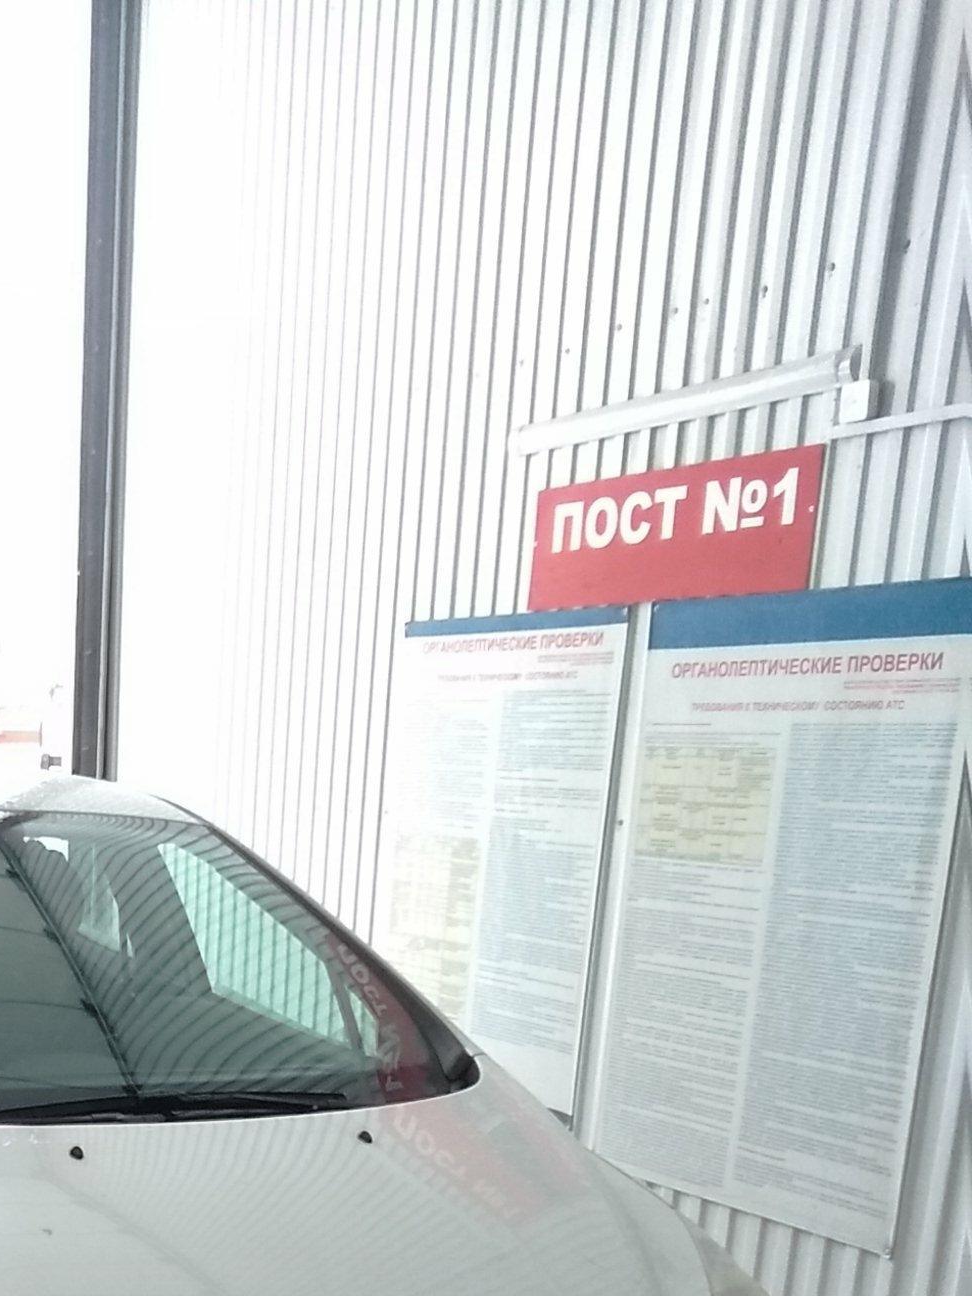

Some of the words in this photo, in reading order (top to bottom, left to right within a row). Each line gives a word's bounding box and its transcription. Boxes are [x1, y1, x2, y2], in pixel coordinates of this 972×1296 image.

[551, 485, 689, 554] ПОСТ
[701, 467, 800, 536] №1
[539, 631, 605, 649] ПРОВЕРКИ
[671, 656, 843, 679] ОРГАНОЛЕПТИЧЕСКИЕ
[846, 652, 945, 673] ПРОВЕРКИ
